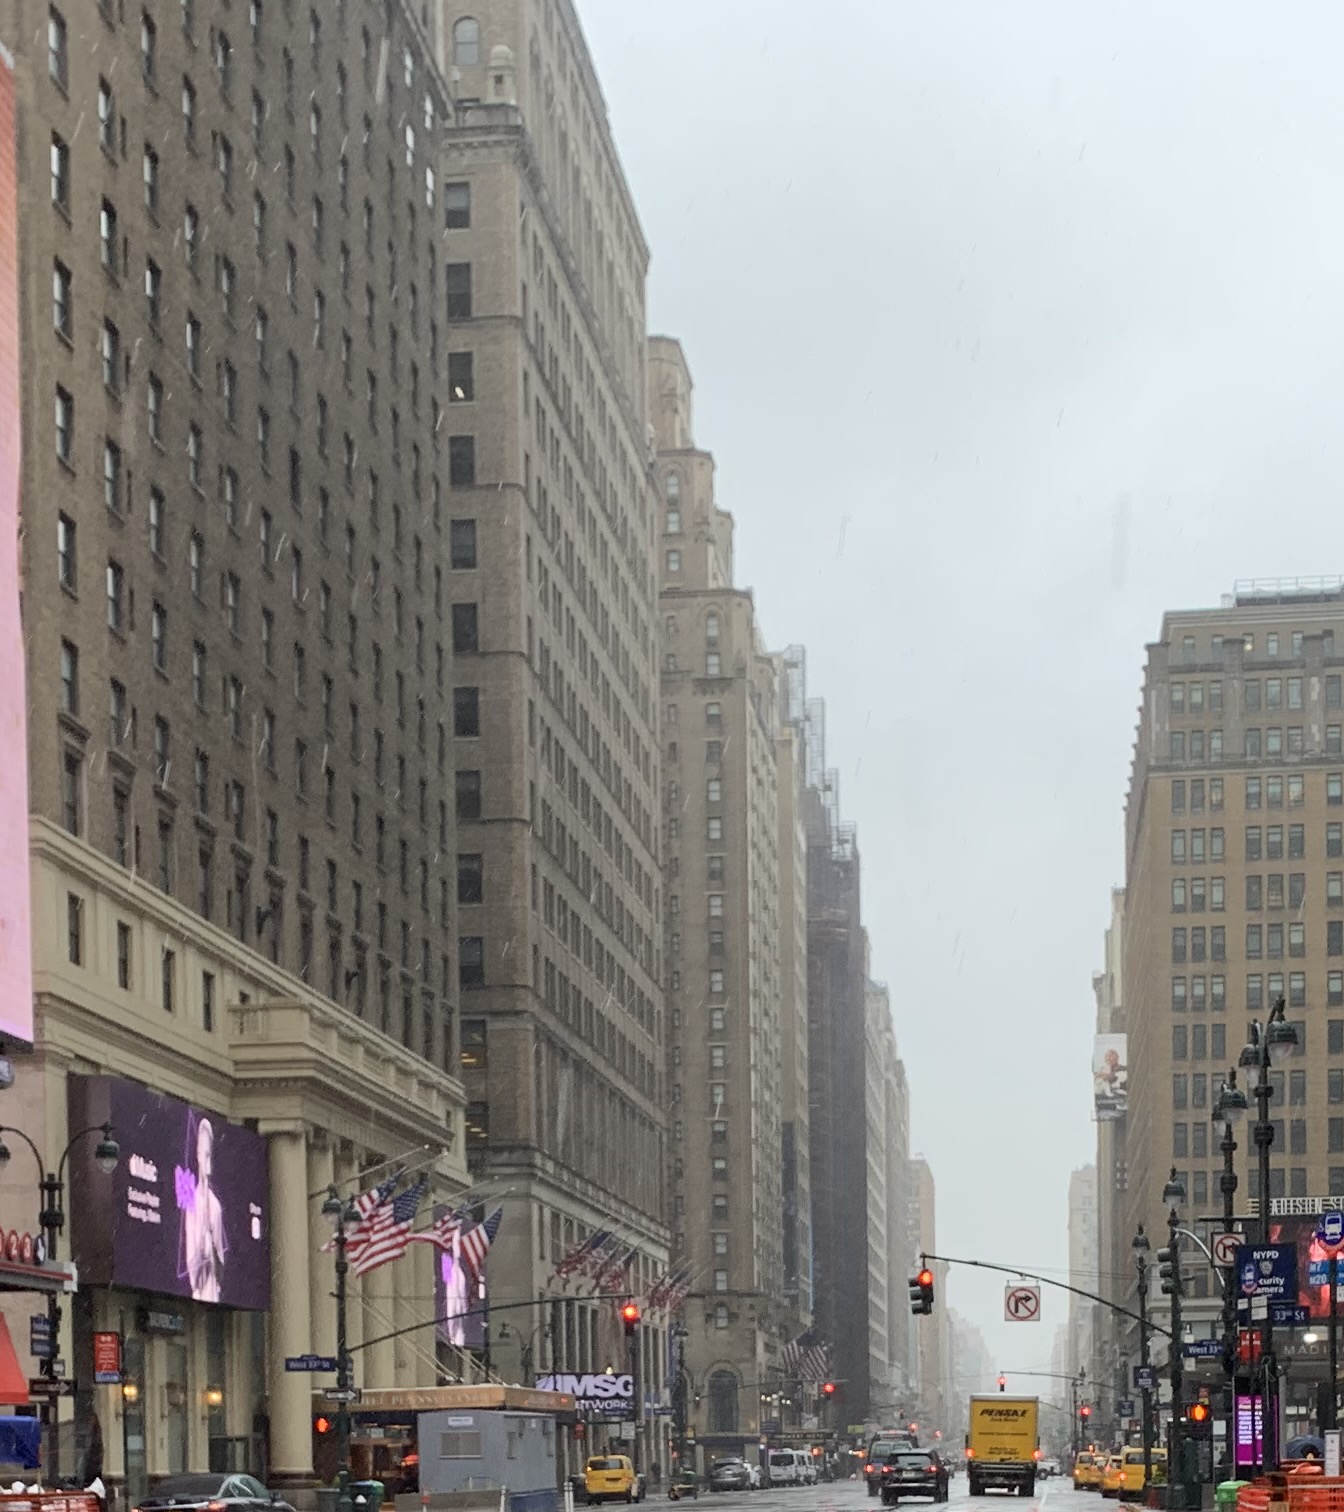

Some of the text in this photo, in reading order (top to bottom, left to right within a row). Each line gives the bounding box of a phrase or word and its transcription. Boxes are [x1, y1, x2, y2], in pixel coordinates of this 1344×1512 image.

[1270, 1197, 1324, 1216] ADISON
[1253, 1250, 1280, 1260] NYPD
[1258, 1277, 1285, 1286] curity
[1255, 1286, 1285, 1295] amera
[1188, 1345, 1208, 1355] West
[563, 1374, 634, 1398] MSG
[979, 1408, 1030, 1418] PENSKE
